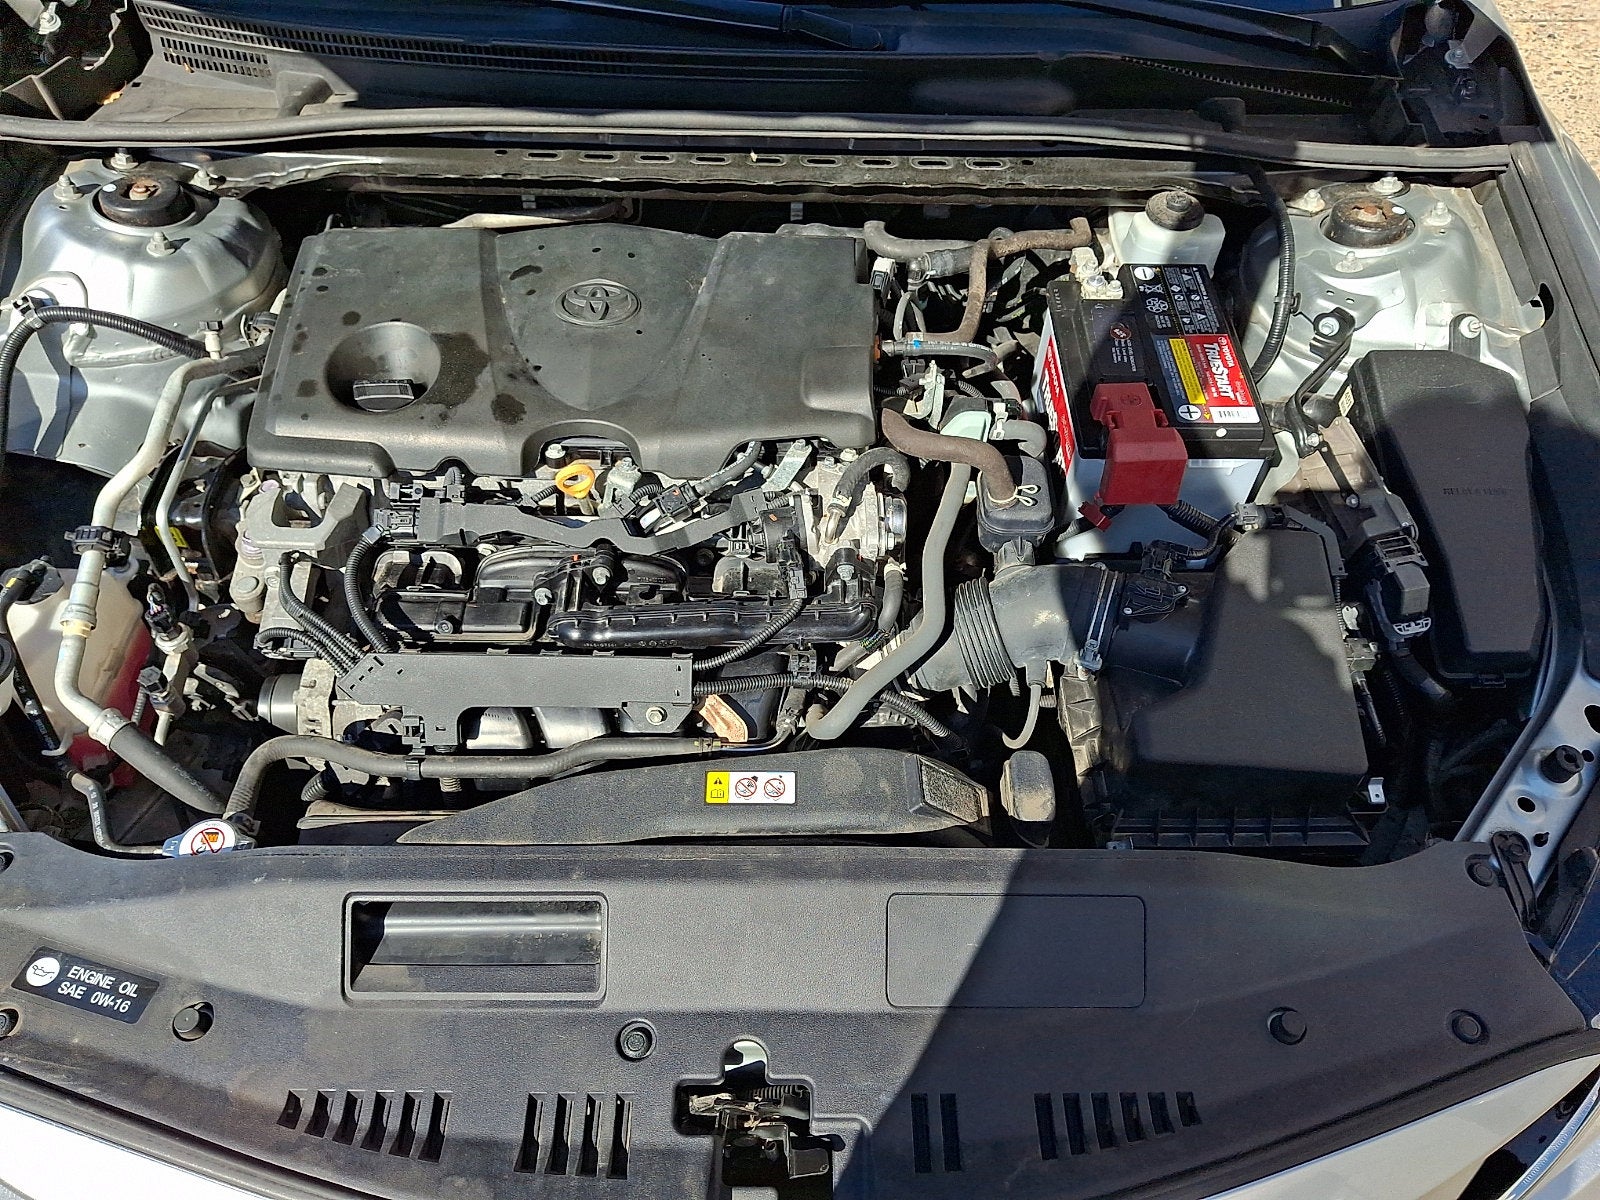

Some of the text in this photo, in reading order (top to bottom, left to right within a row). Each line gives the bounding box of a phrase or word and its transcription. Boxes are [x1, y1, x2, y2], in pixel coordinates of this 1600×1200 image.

[1222, 345, 1235, 367] TOYOTA
[57, 981, 132, 1013] SAE 0W-16
[67, 965, 139, 998] ENGINE OIL
